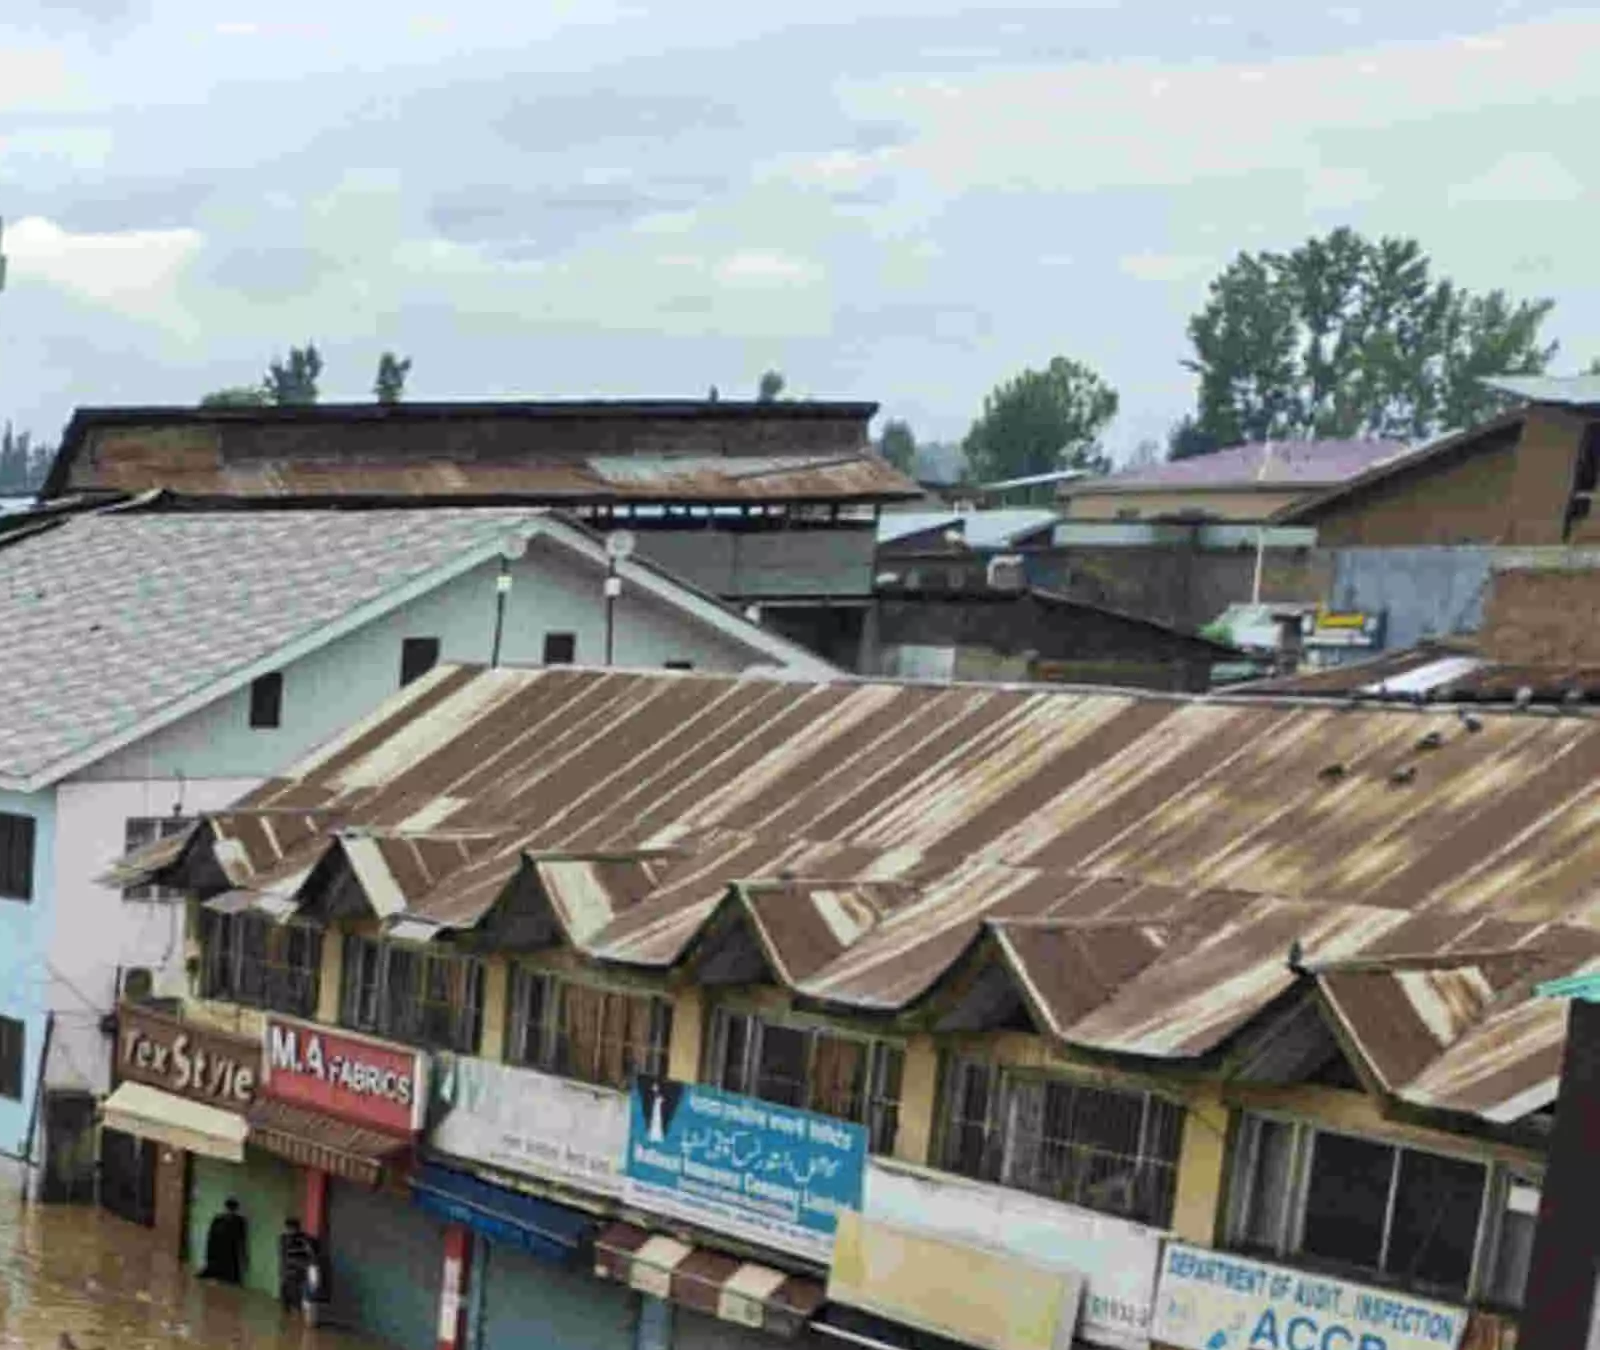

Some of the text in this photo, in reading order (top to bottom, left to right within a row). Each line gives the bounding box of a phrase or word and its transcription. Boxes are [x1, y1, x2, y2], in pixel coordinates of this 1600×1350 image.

[271, 1025, 410, 1101] M.A FABRICS
[1168, 1249, 1267, 1294] DEPARTMENT
[1270, 1274, 1293, 1297] OF
